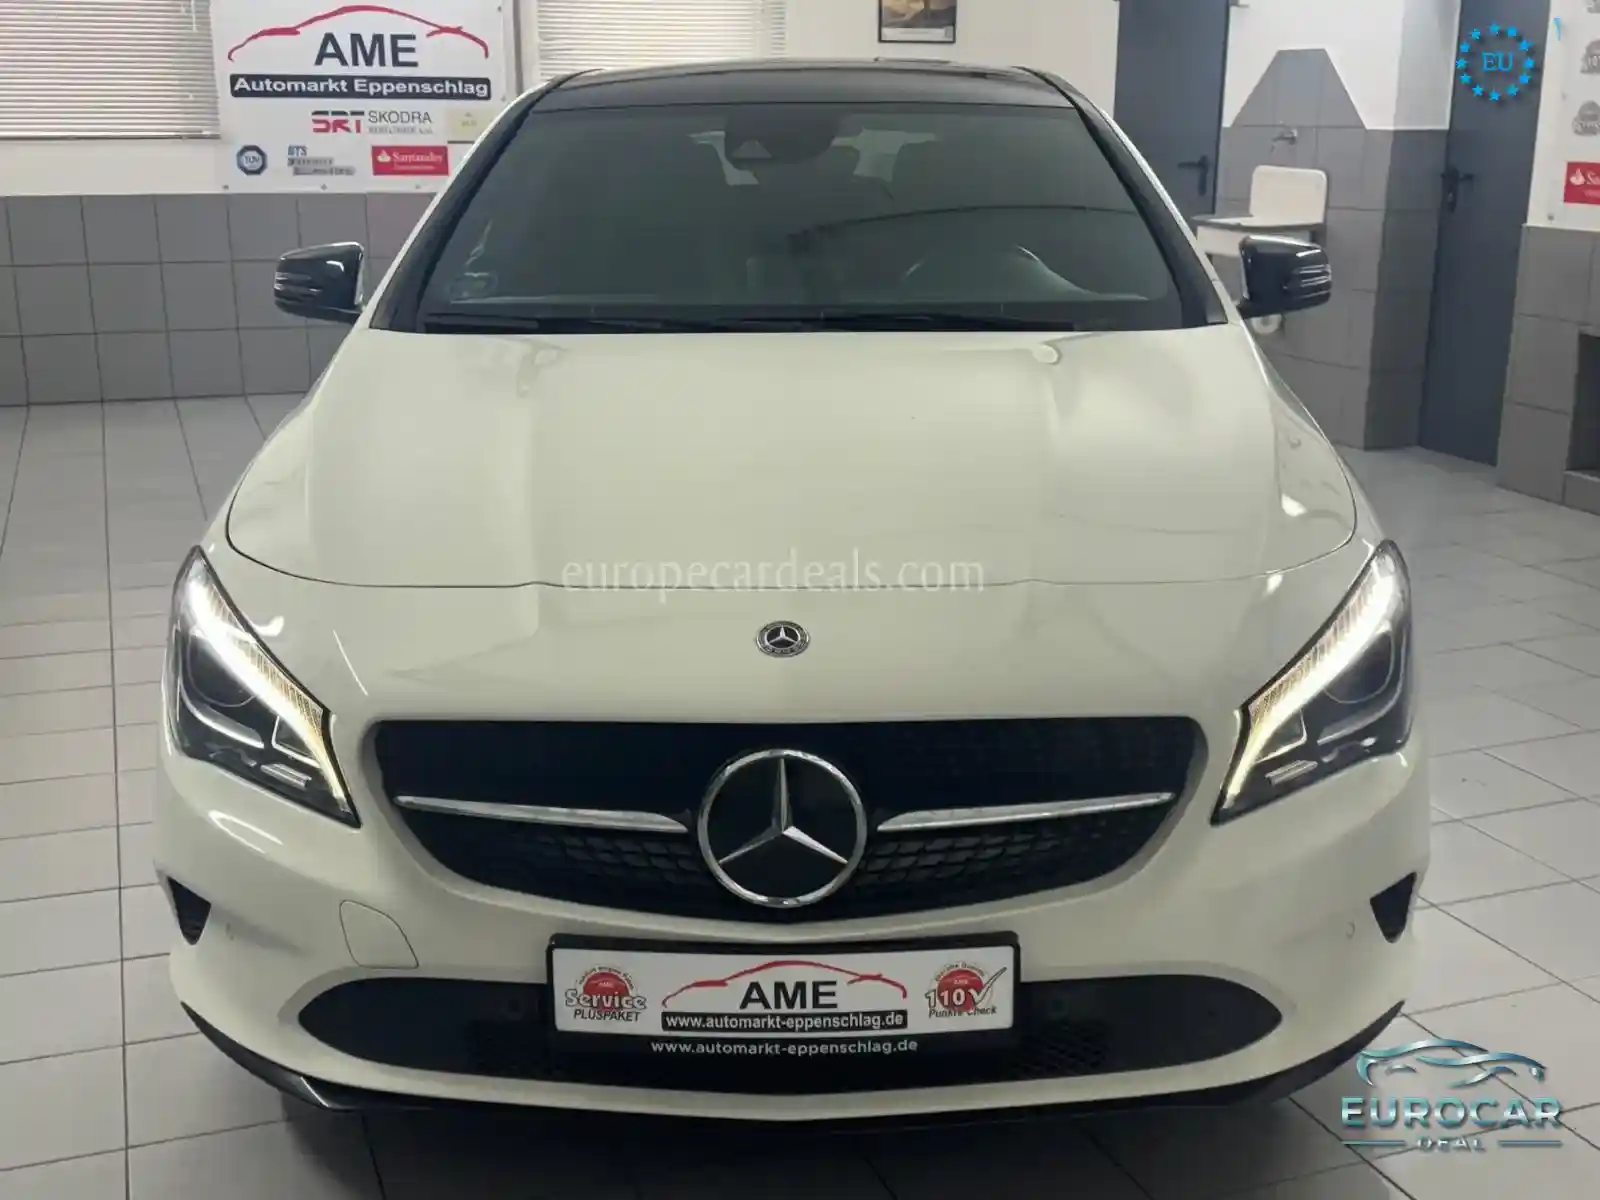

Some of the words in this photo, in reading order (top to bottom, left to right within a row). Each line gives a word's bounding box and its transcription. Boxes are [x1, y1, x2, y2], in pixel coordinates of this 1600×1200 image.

[314, 32, 419, 67] AME
[233, 76, 348, 94] Automarkt
[353, 78, 489, 98] Eppenschlag
[367, 110, 433, 125] SKODRA
[564, 988, 647, 1010] Service
[740, 980, 838, 1010] AME
[573, 1008, 641, 1022] PLUSPAKET
[666, 1011, 904, 1032] www.automarkt-eppenschlag.de
[650, 1038, 919, 1057] www.automarkt-eppenschlag.de
